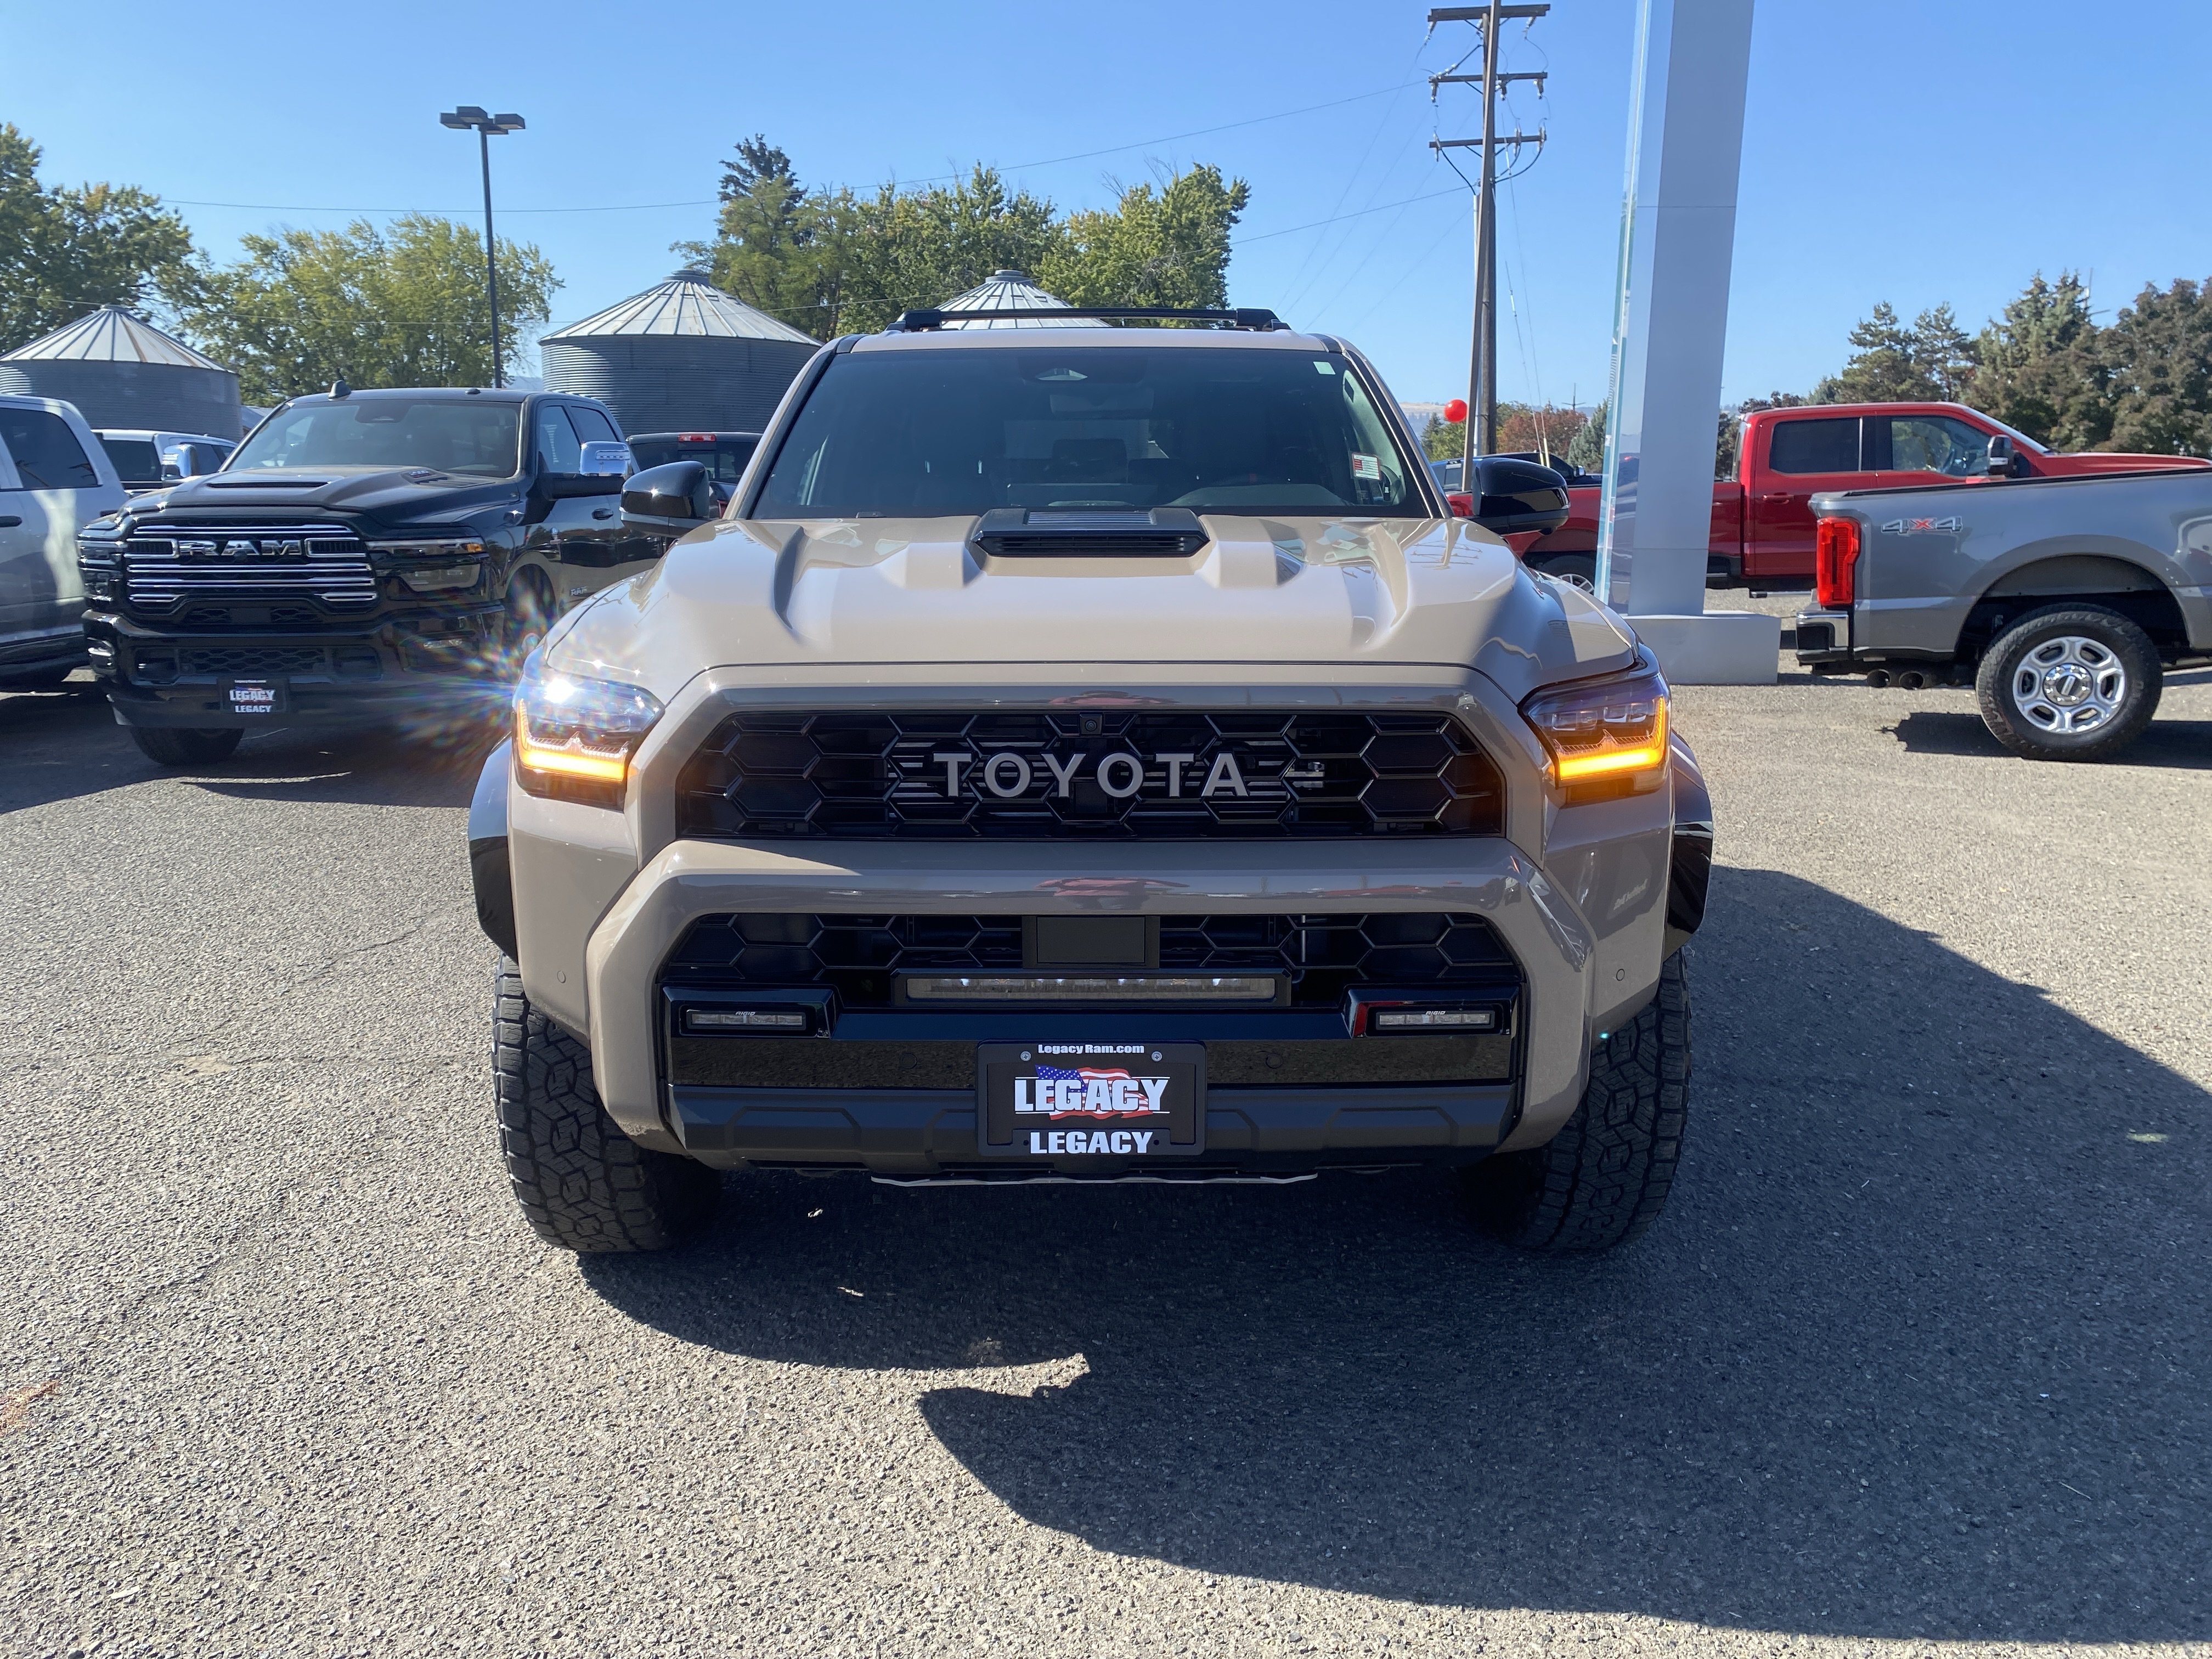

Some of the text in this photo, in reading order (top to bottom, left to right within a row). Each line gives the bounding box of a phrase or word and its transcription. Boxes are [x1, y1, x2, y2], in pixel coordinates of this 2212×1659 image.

[179, 540, 302, 555] RAM
[229, 691, 274, 700] LEGACY
[933, 752, 1249, 797] TOYOTA
[1015, 1080, 1169, 1111] LEGACY
[1030, 1132, 1153, 1154] LEGACY
